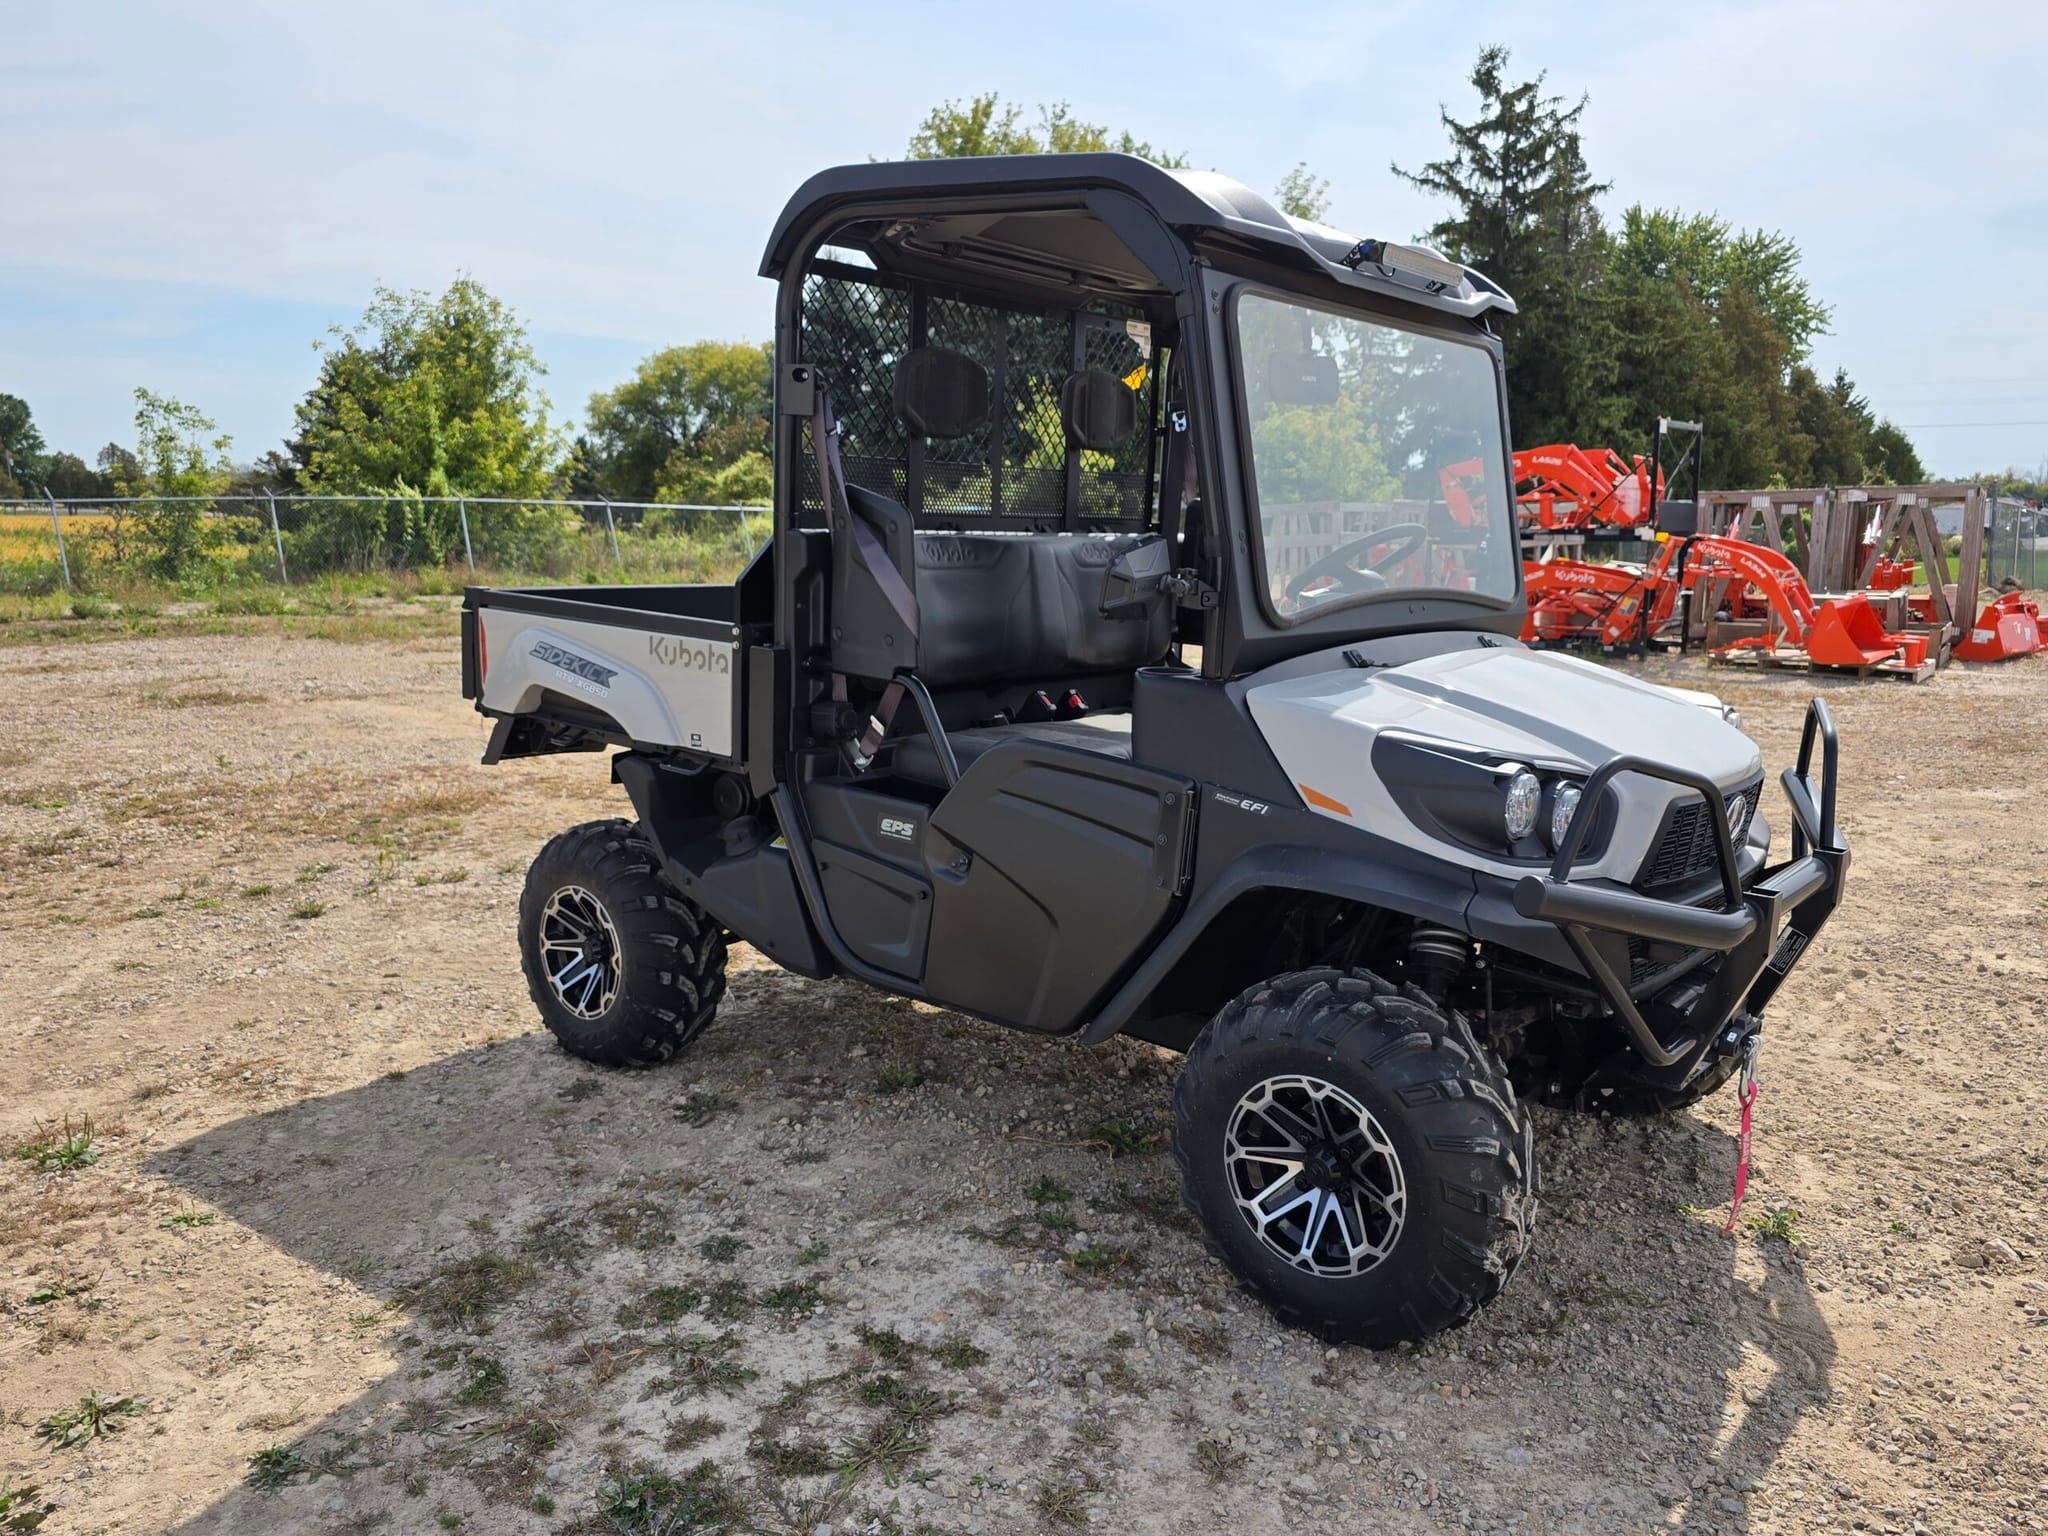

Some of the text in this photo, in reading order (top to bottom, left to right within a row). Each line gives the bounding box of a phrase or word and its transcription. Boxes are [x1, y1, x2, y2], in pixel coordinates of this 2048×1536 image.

[1555, 569, 1596, 584] Kubota
[649, 635, 729, 675] Kubota
[529, 641, 618, 688] SIDEKICK
[576, 679, 609, 698] XG850
[1240, 799, 1269, 815] EFI
[881, 818, 914, 836] EPS
